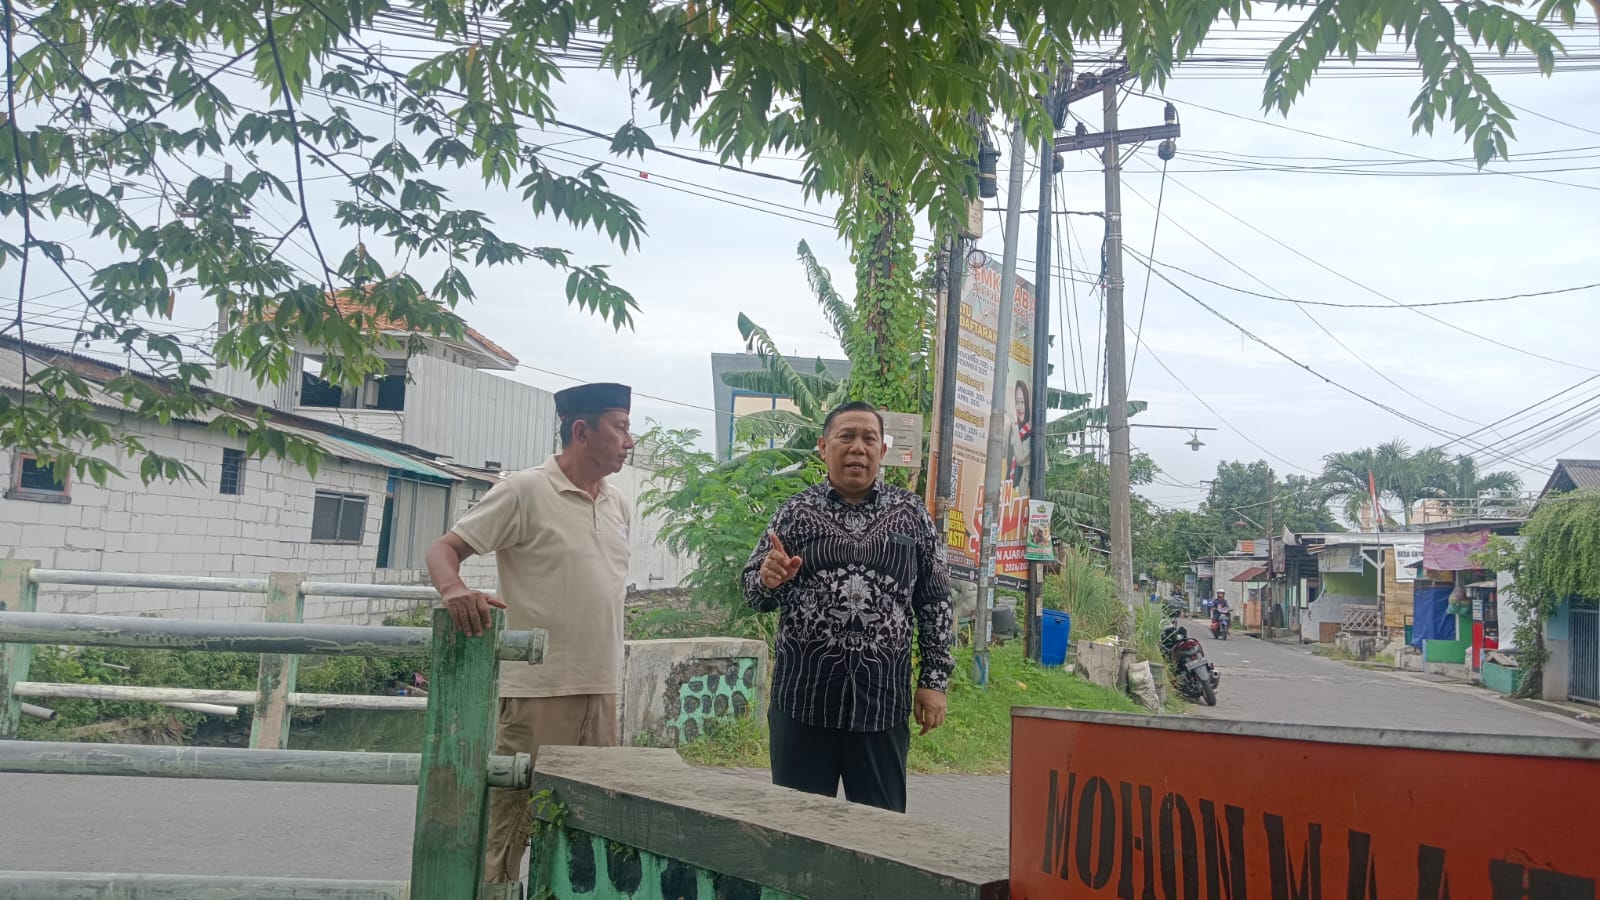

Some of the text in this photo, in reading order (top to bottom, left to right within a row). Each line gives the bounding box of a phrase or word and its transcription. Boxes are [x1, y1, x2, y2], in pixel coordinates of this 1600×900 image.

[959, 317, 997, 343] DAFTARAN
[959, 349, 978, 364] OVEMBER
[1003, 549, 1025, 560] AJARA
[1042, 769, 1247, 900] MOHON
